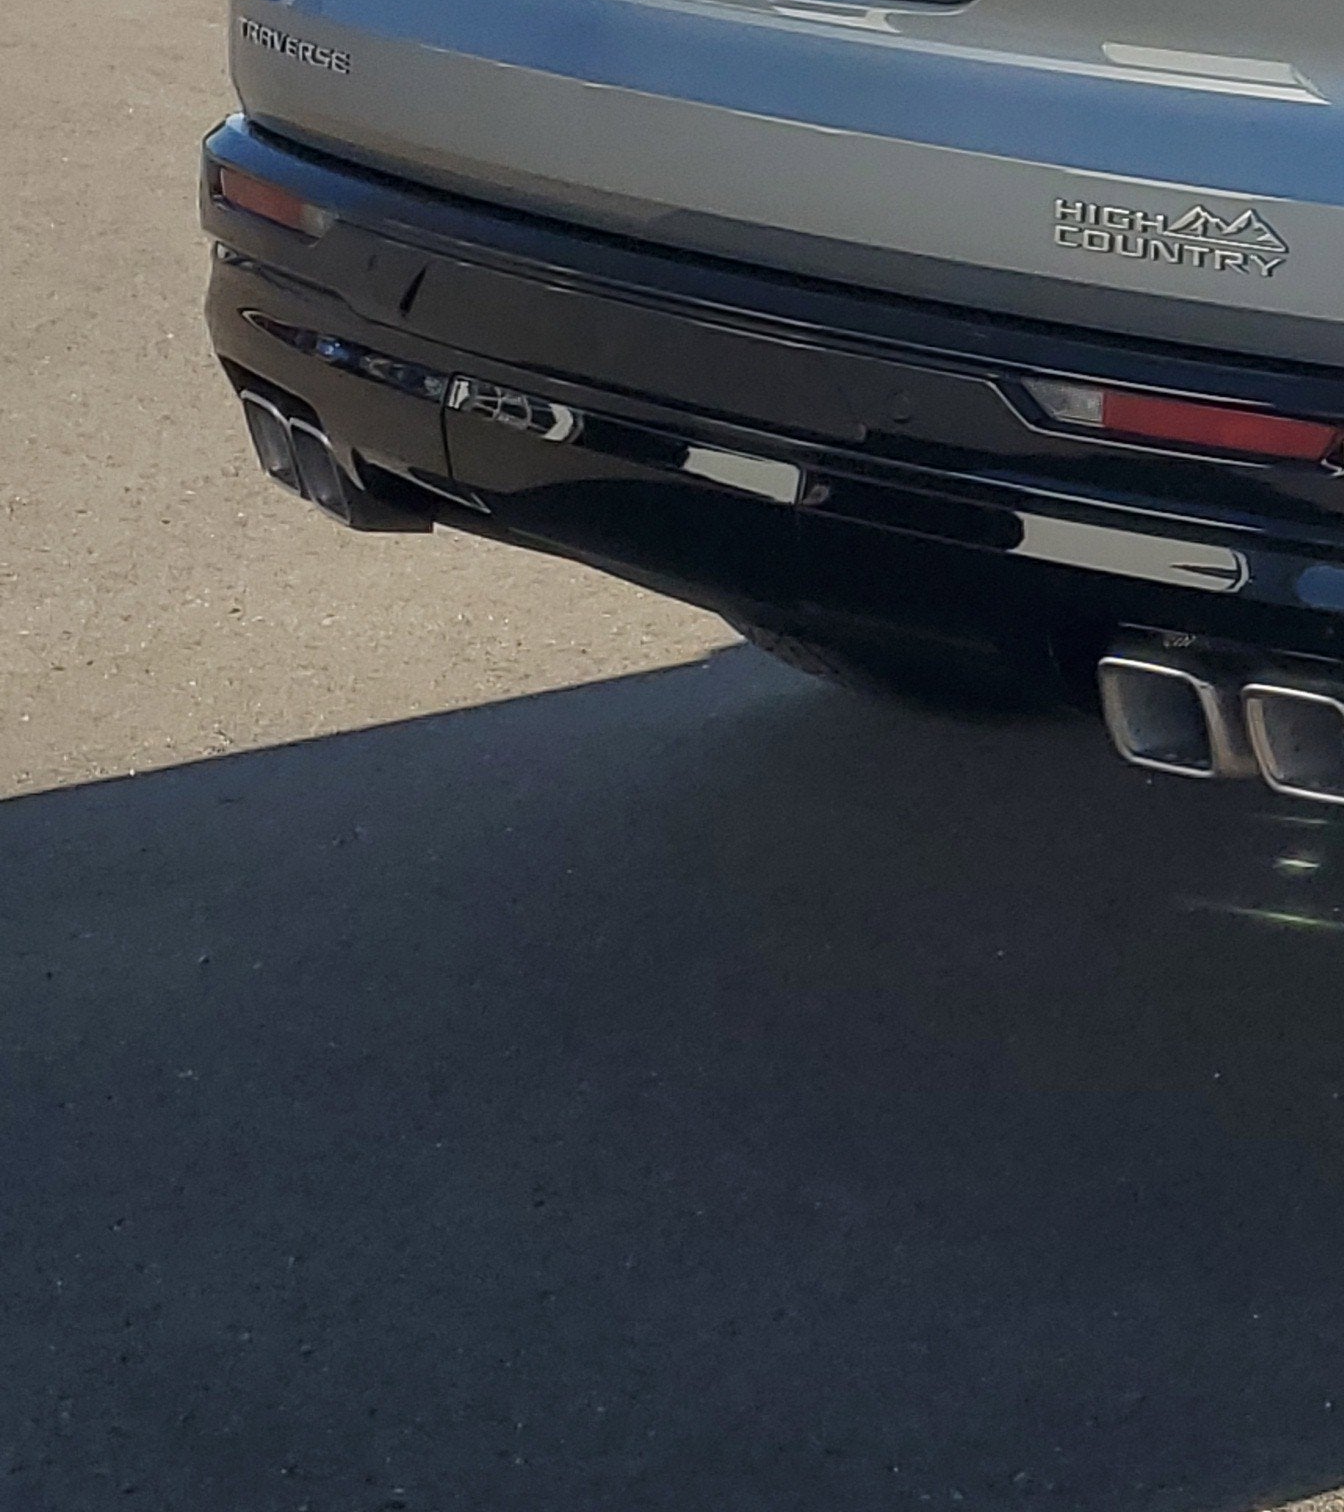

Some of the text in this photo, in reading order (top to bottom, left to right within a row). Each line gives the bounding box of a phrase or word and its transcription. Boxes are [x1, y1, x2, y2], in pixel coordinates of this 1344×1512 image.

[238, 16, 350, 74] TRAVERSE
[1054, 199, 1166, 235] HIGH
[1053, 224, 1285, 277] COUNTRY
